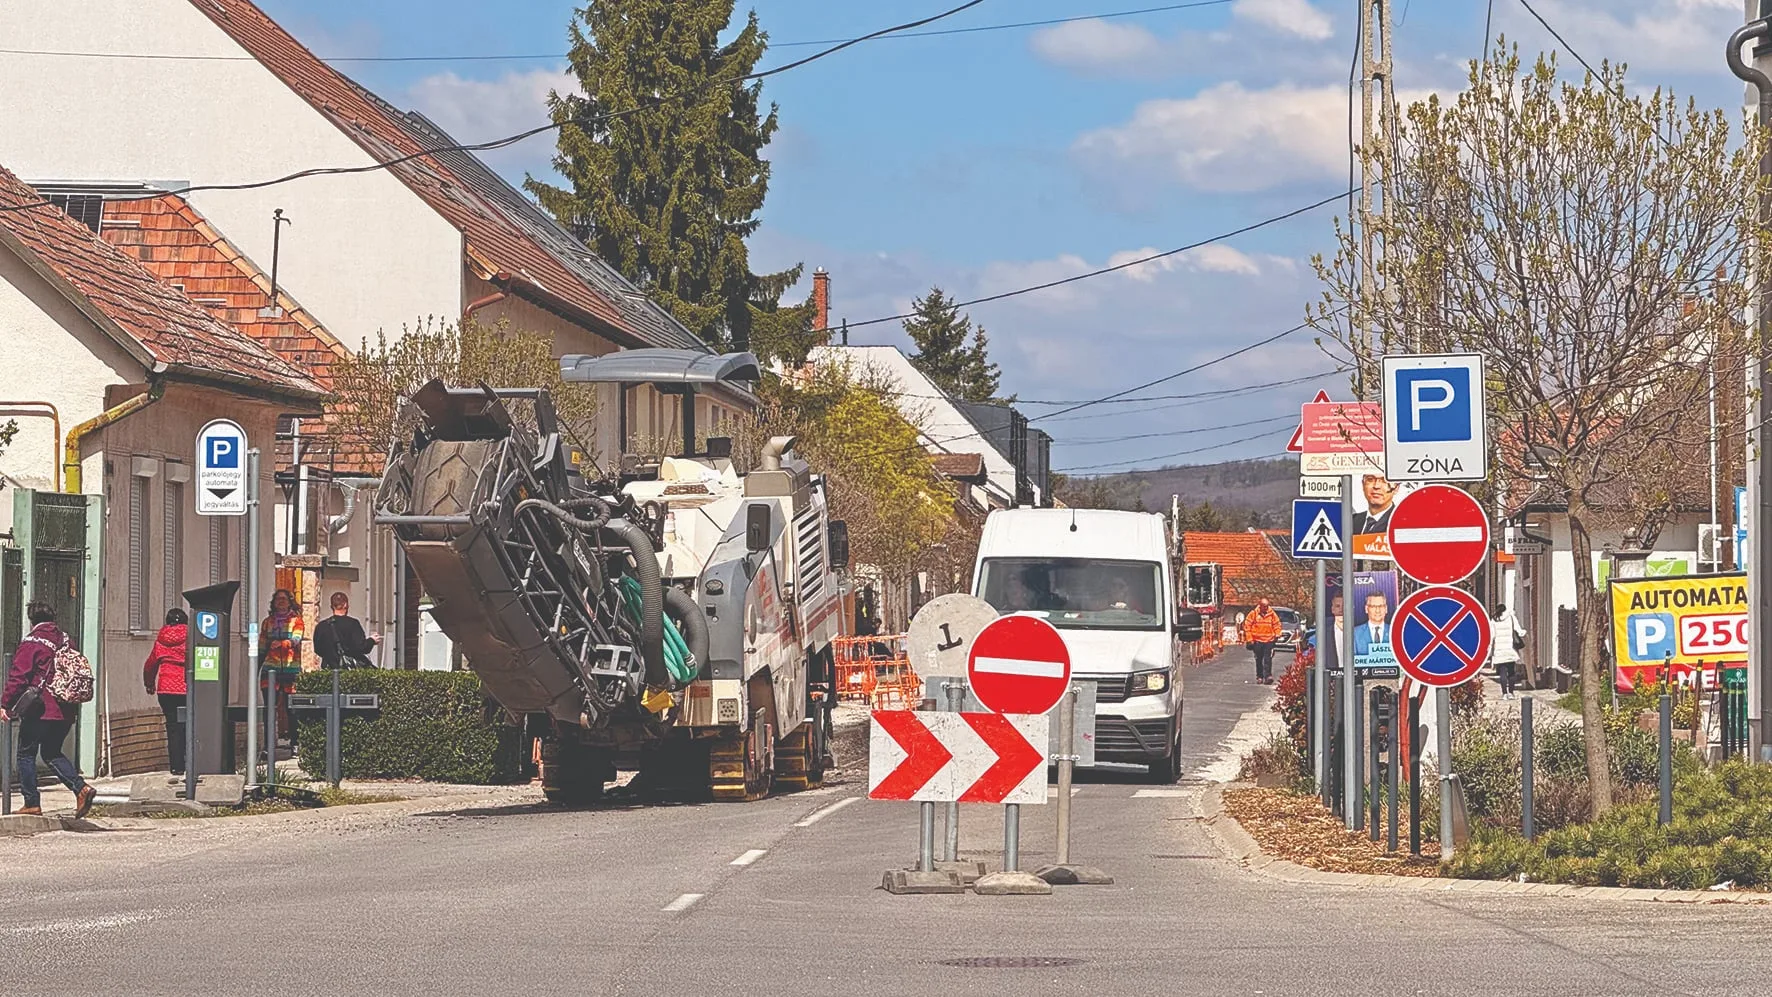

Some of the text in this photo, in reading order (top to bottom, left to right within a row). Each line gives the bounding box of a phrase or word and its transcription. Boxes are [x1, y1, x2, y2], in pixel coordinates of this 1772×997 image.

[1410, 379, 1455, 431] P
[213, 440, 232, 465] P
[1331, 456, 1383, 466] GENERAL
[1407, 454, 1464, 473] ZÓNA
[203, 501, 240, 509] jegyváltás
[1354, 576, 1375, 585] ISZA
[1630, 586, 1748, 610] AUTOMATA
[1635, 618, 1667, 656] P
[197, 648, 217, 656] 2101
